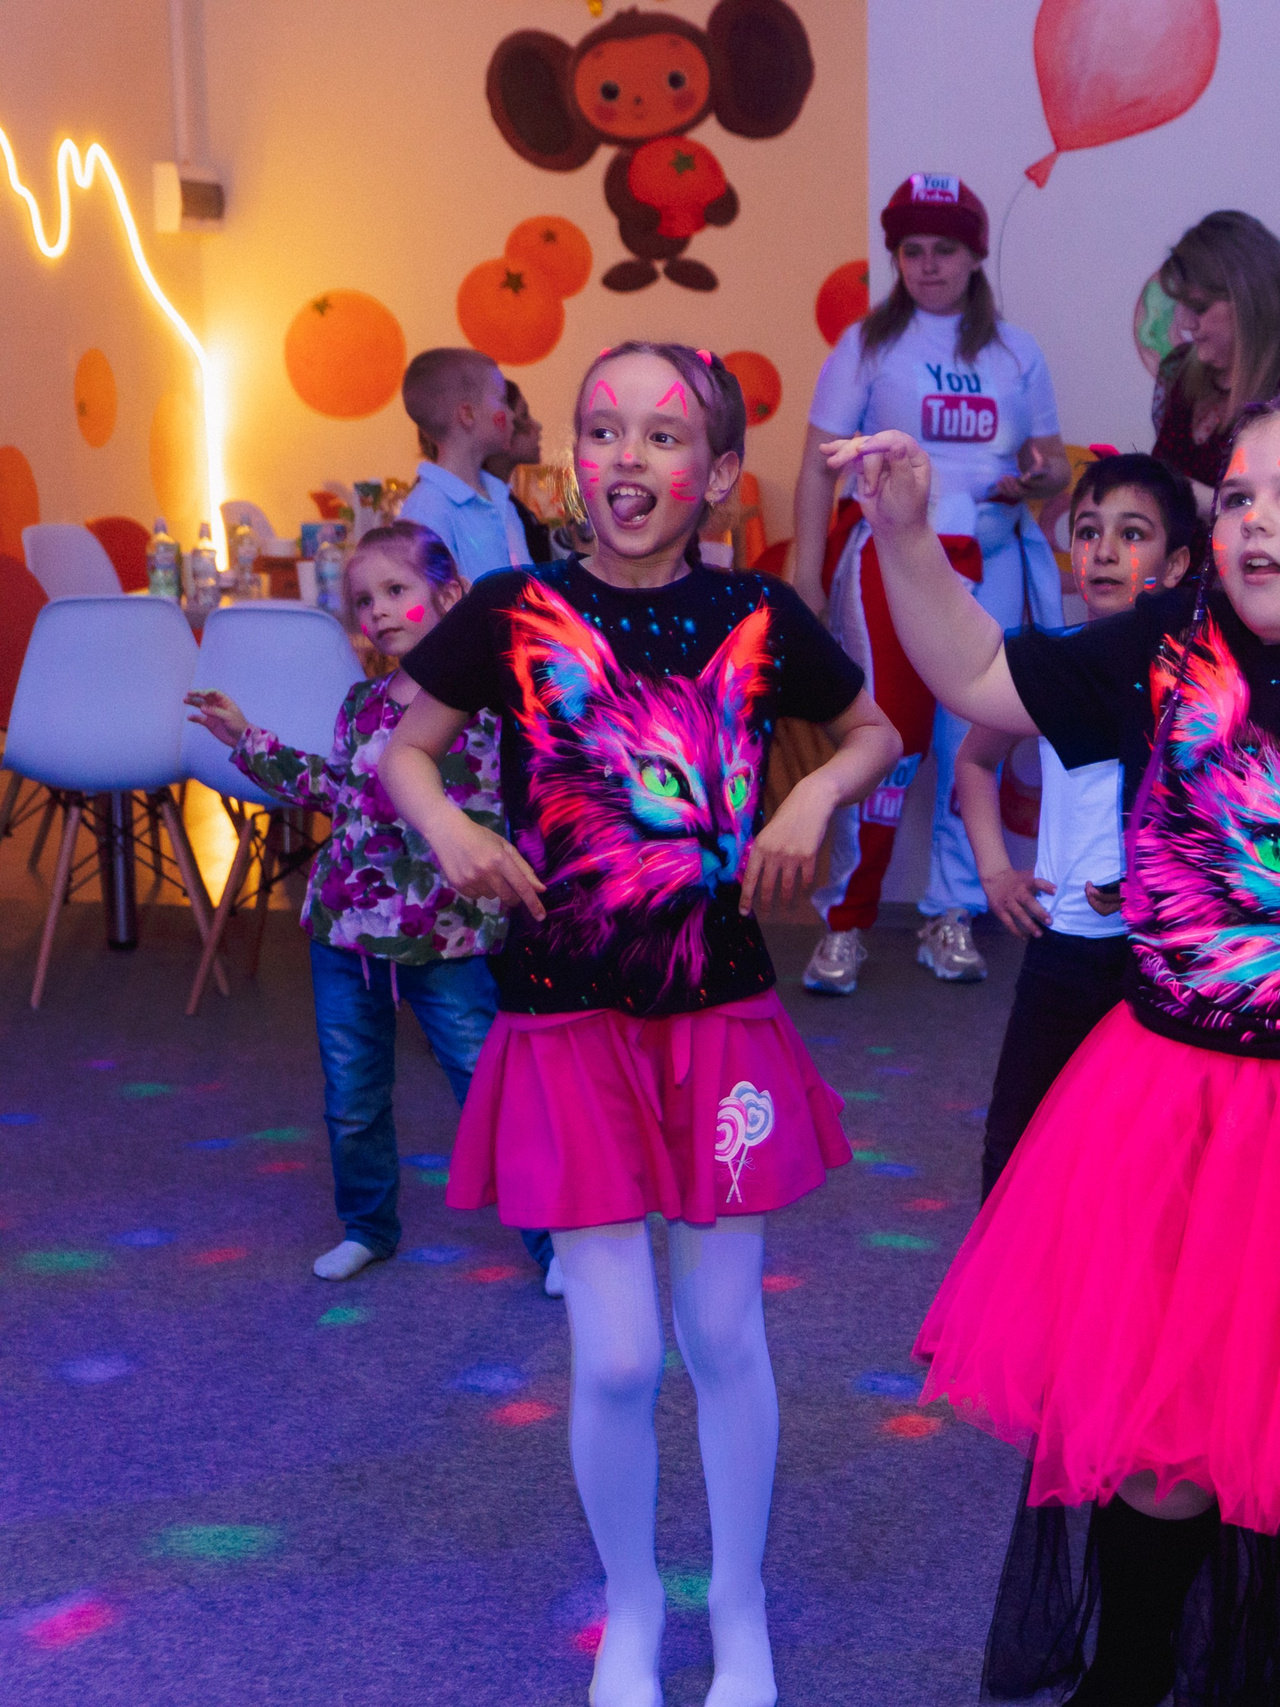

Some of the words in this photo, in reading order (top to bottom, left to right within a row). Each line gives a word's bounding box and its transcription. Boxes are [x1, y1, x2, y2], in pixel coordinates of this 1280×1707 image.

[924, 173, 949, 188] You
[926, 363, 982, 393] You
[926, 400, 994, 437] Tube
